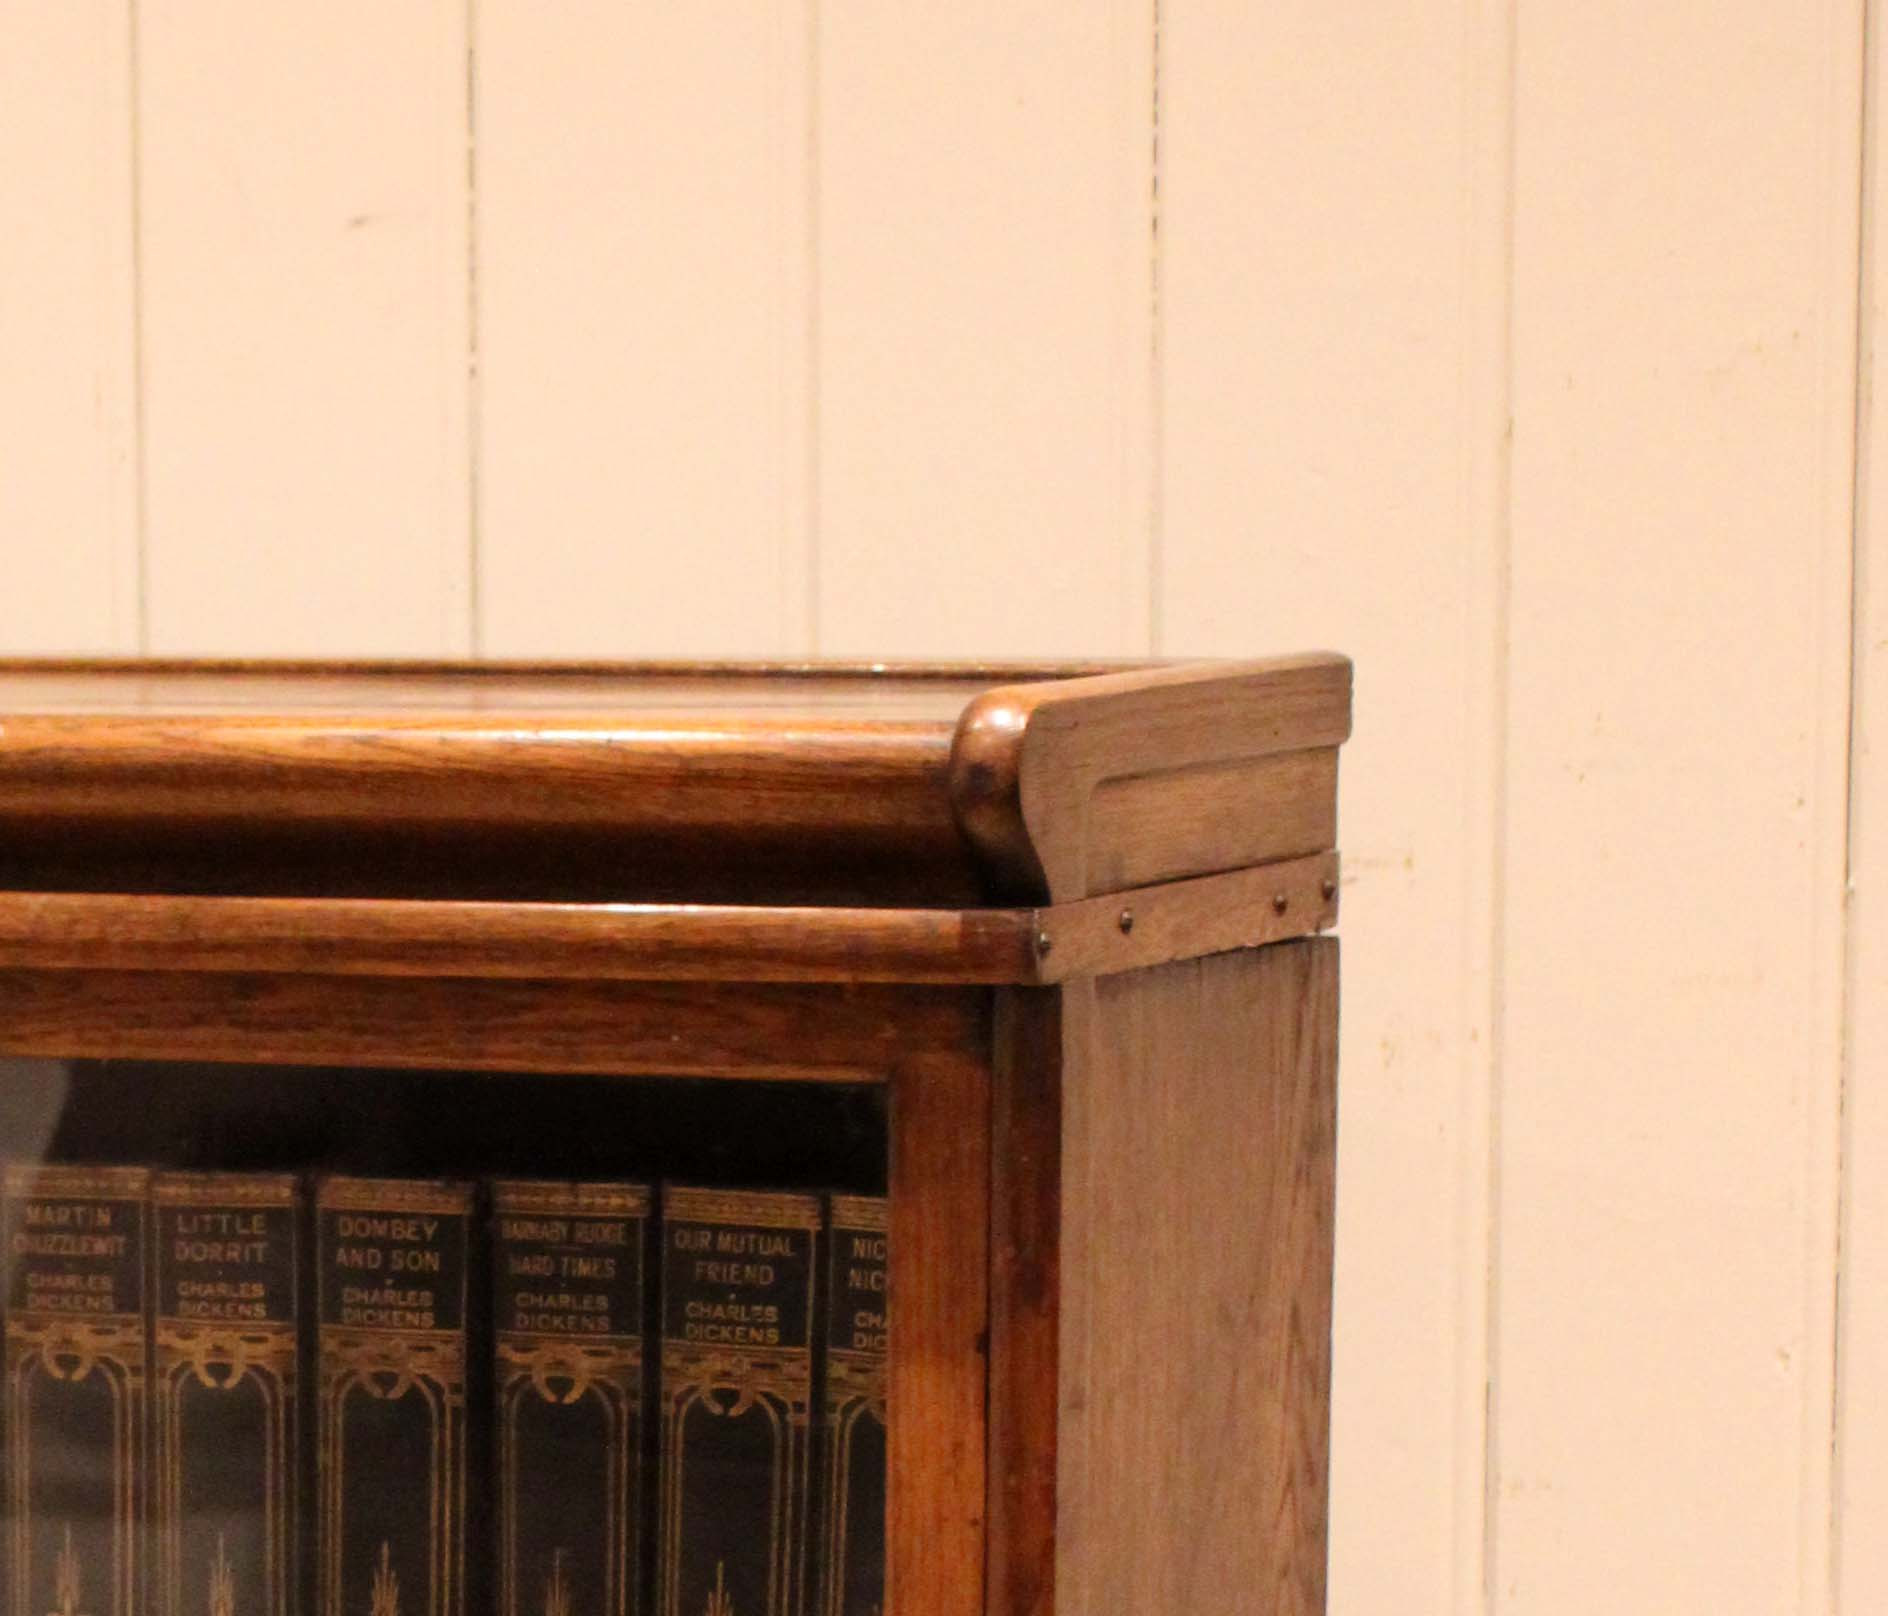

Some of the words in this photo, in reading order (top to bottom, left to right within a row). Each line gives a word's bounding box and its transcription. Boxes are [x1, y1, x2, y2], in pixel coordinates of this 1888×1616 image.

[26, 1205, 112, 1227] MARTIN
[176, 1213, 267, 1236] LITTLE
[337, 1215, 440, 1242] DOMBEY
[501, 1219, 569, 1243] BARNABY
[573, 1222, 628, 1246] RUDGE
[12, 1232, 127, 1258] CHUZZLEWIT
[173, 1240, 269, 1264] DORRIT
[673, 1228, 713, 1251] OUR
[715, 1230, 798, 1257] MUTUAL
[852, 1237, 887, 1261] NIC
[335, 1246, 382, 1270] AND
[391, 1249, 440, 1273] SON
[509, 1254, 555, 1277] HARD
[560, 1256, 617, 1280] TIMES
[26, 1272, 113, 1292] CHARLES
[694, 1260, 776, 1287] FRIEND
[848, 1267, 887, 1293] NIC
[175, 1280, 266, 1300] CHARLES
[342, 1286, 434, 1308] CHARLES
[514, 1291, 610, 1313] CHARLES
[26, 1293, 114, 1312] DICKENS
[176, 1300, 267, 1320] DICKENS
[684, 1299, 780, 1325] CHARLES
[342, 1307, 434, 1329] DICKENS
[514, 1312, 611, 1333] DICKENS
[684, 1321, 780, 1346] DICKENS
[852, 1330, 887, 1351] DIC
